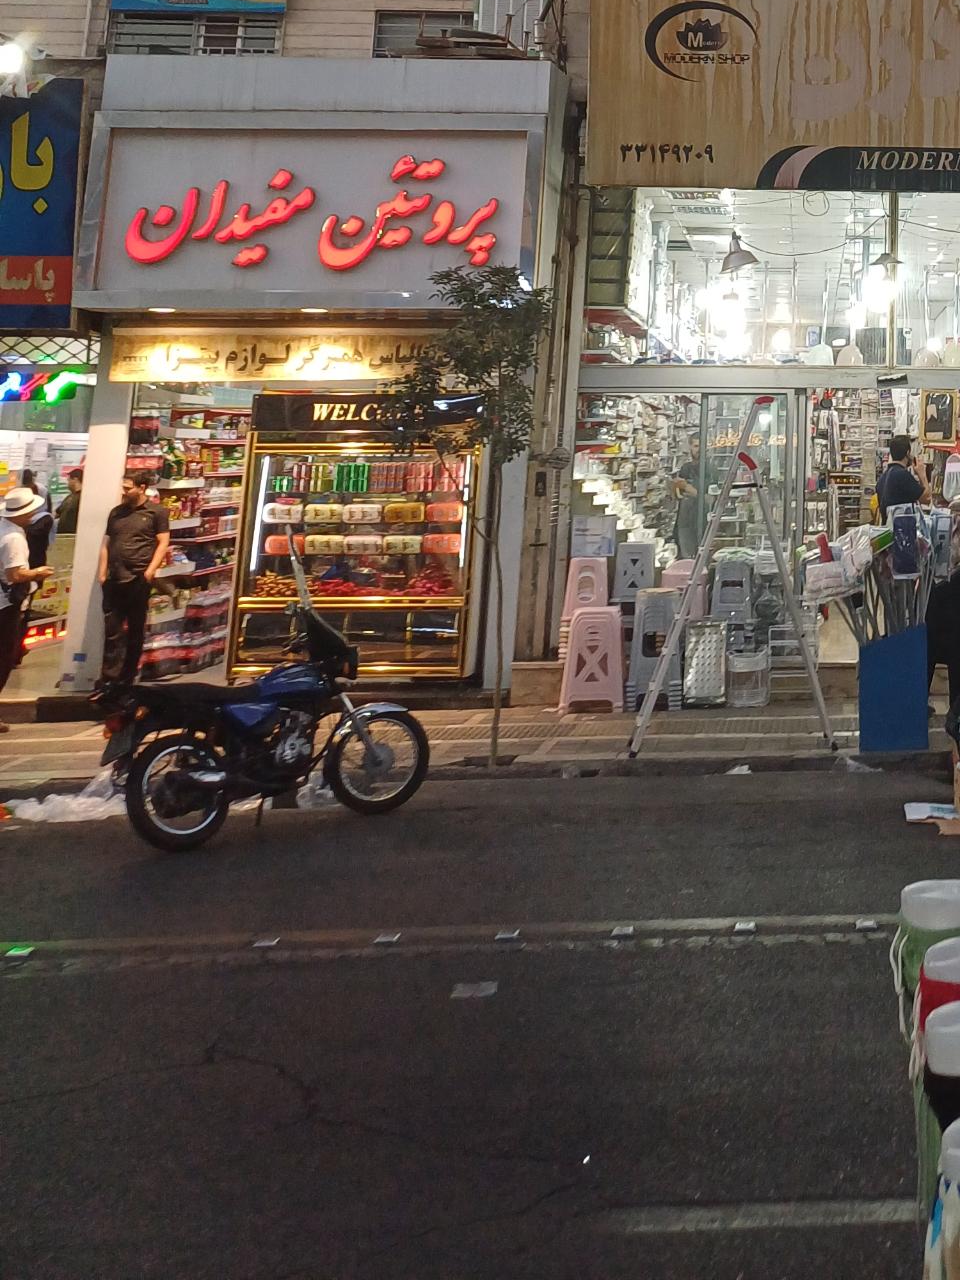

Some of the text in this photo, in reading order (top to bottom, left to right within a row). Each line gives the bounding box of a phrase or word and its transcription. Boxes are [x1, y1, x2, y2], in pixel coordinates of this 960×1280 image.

[717, 53, 751, 65] SHOP
[318, 154, 499, 271] پروتئین
[225, 343, 291, 372] لوازم
